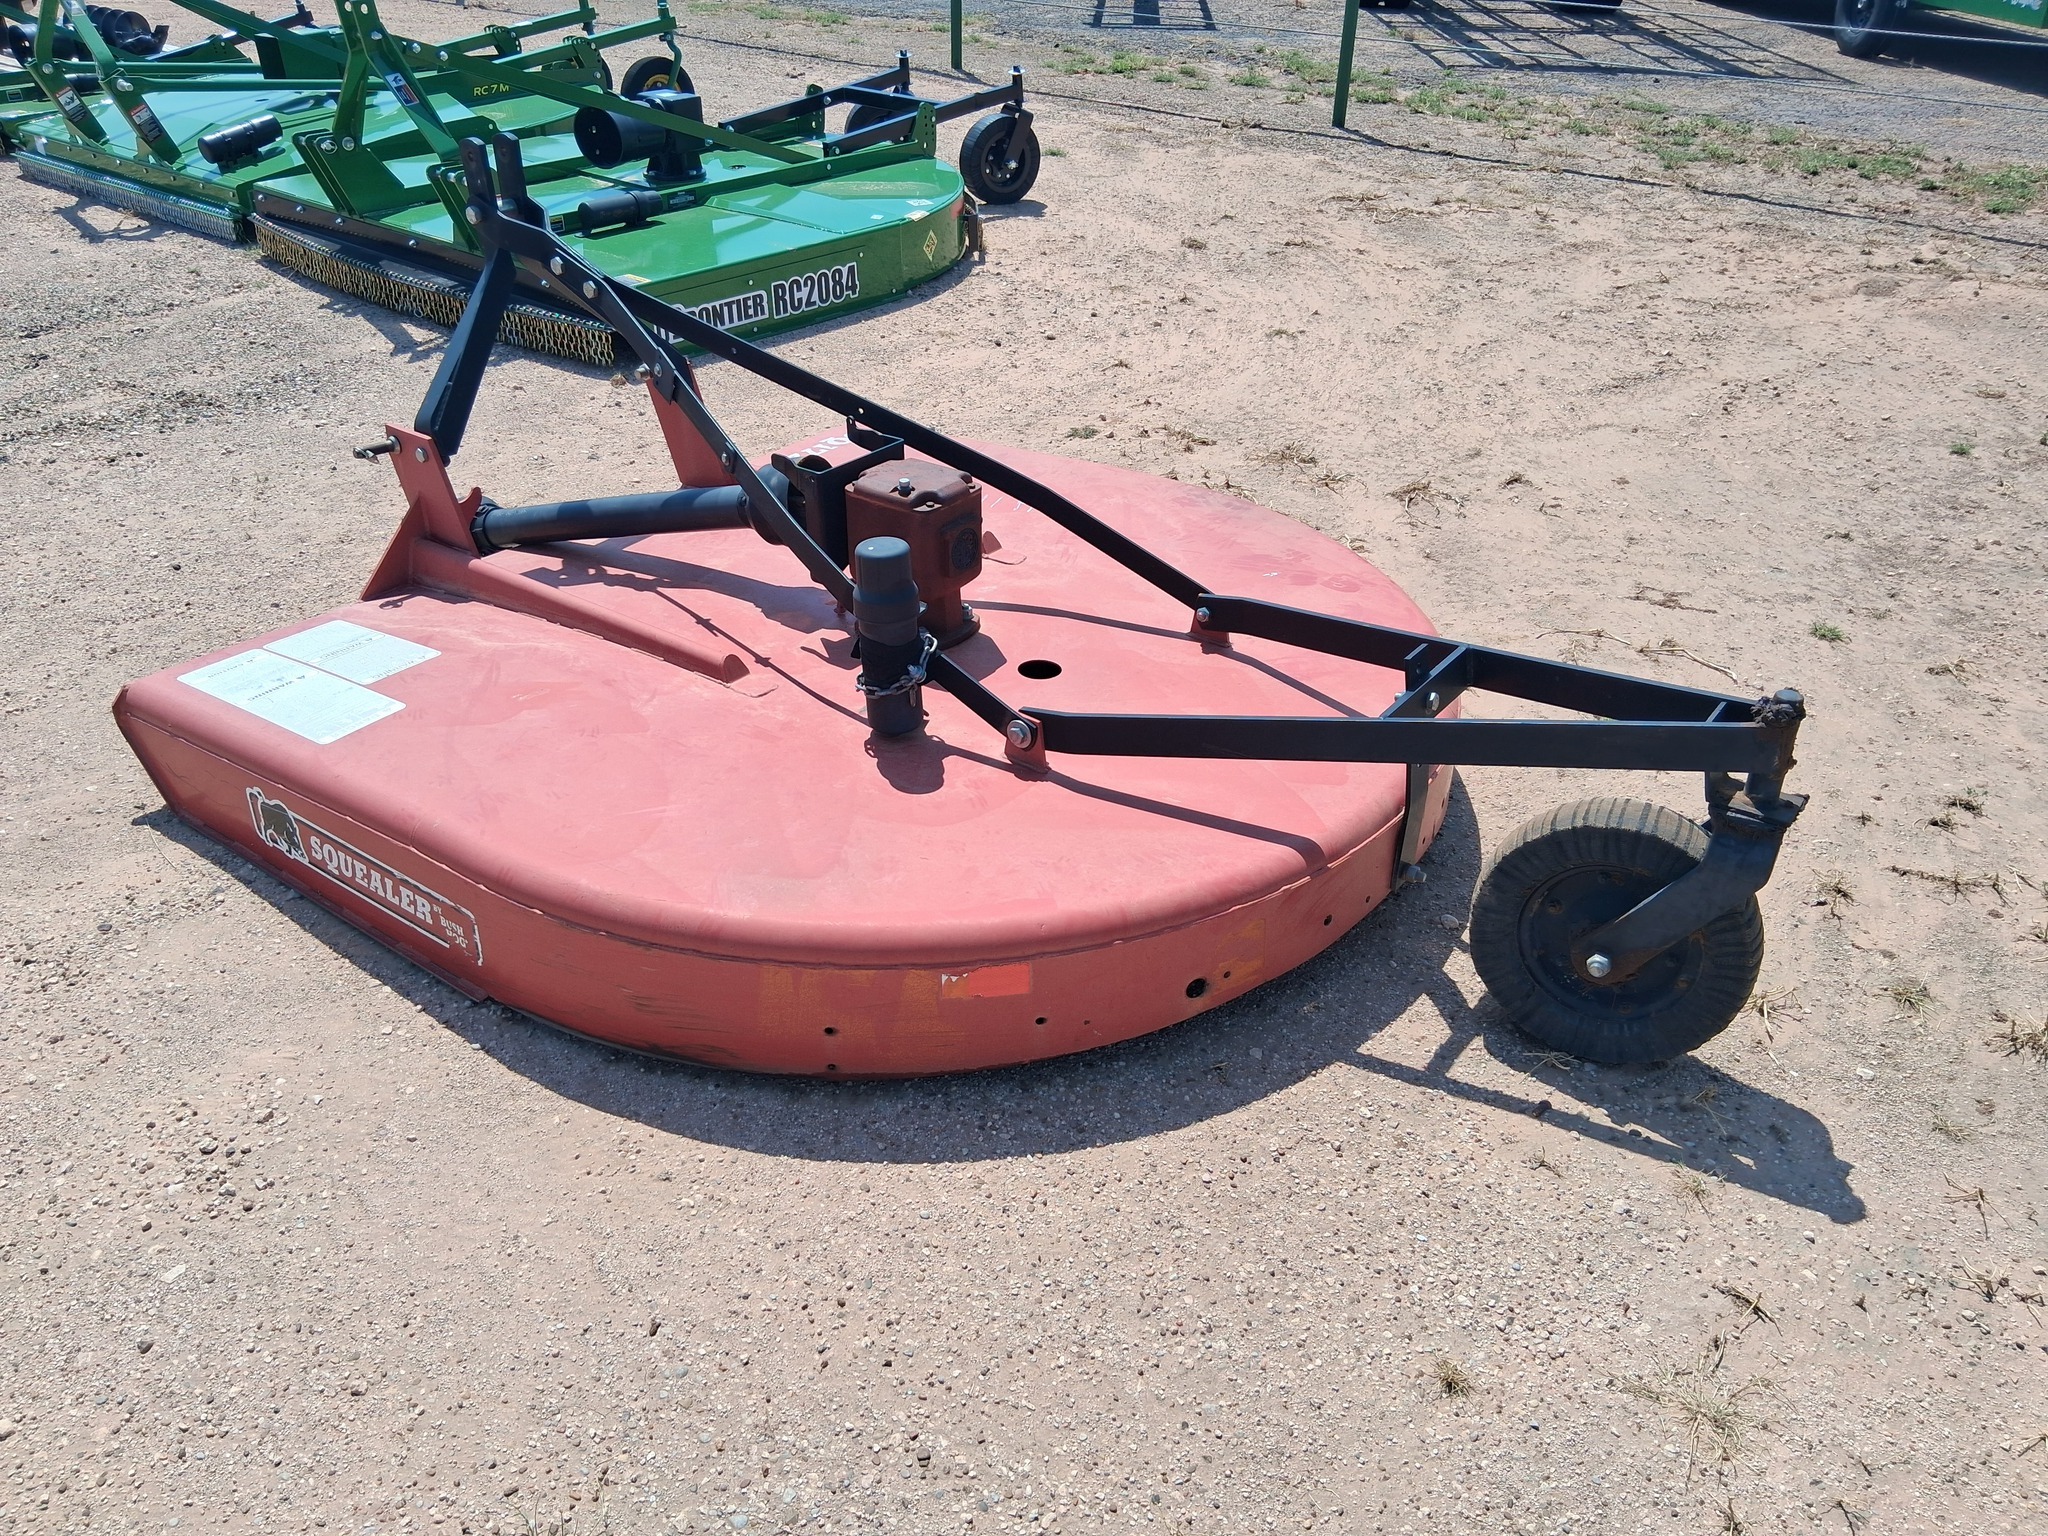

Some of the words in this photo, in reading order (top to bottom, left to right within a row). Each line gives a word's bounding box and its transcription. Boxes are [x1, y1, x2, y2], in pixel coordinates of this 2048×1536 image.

[772, 263, 859, 318] RC2084
[310, 835, 433, 925] SQUEALER
[440, 915, 465, 937] BUSH
